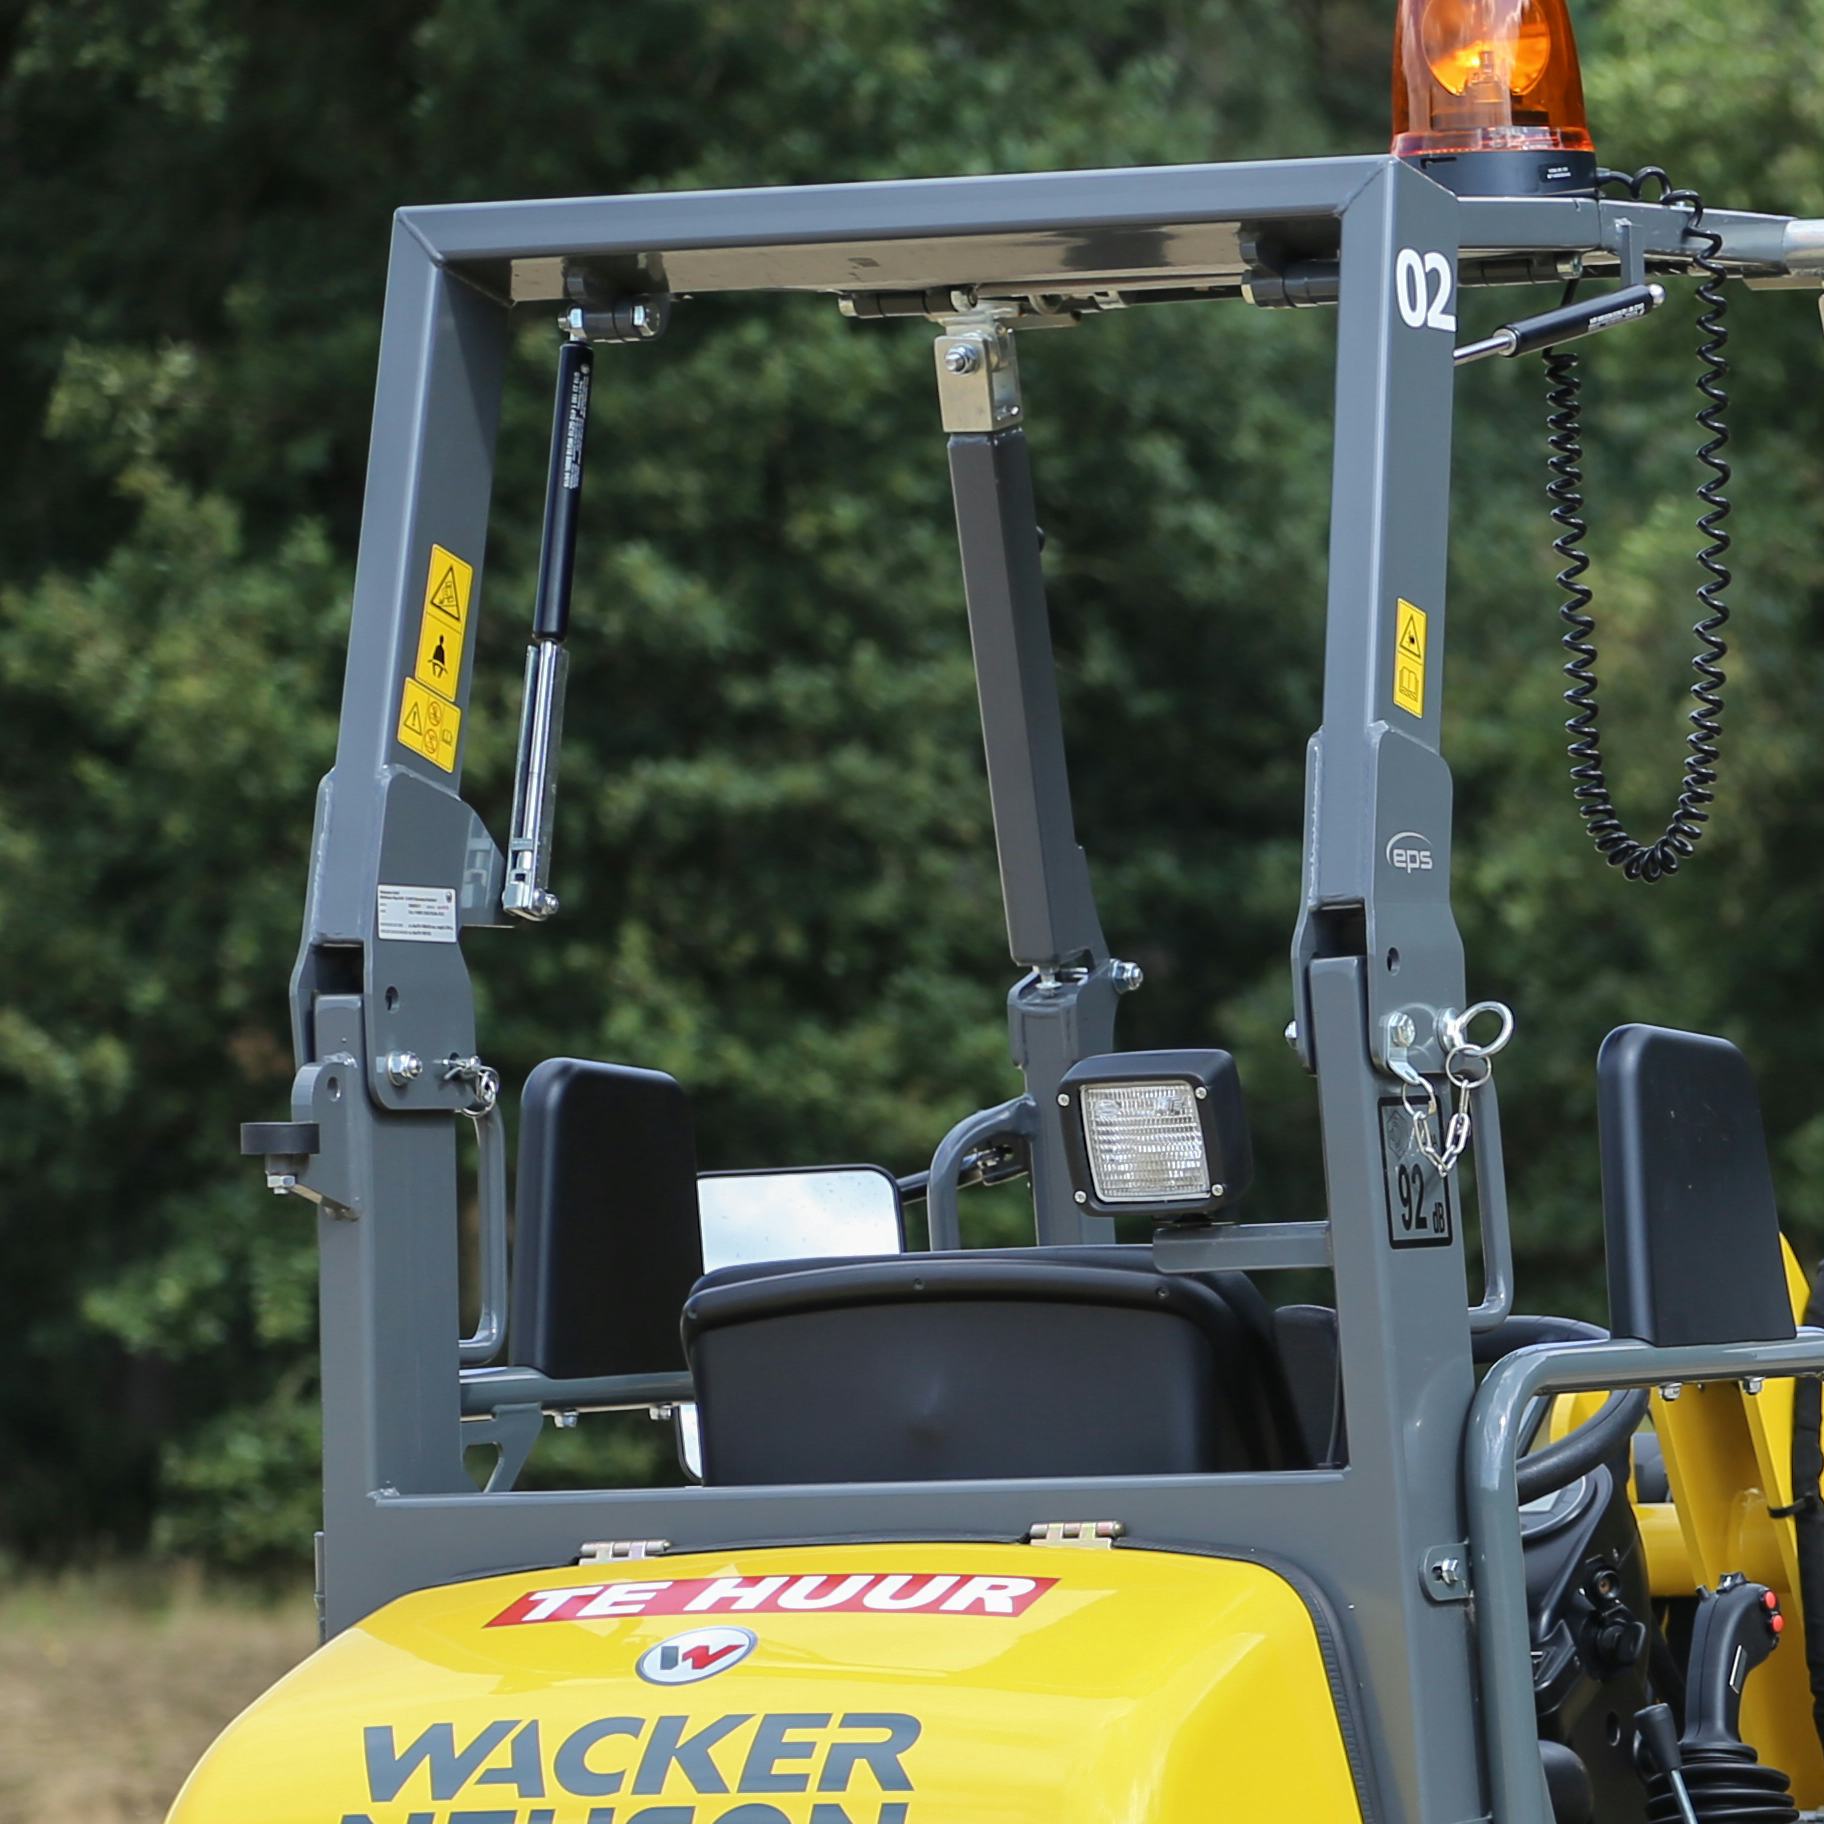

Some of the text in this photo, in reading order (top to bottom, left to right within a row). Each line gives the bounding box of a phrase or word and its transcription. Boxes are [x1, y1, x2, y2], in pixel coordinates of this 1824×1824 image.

[1396, 248, 1457, 332] 02
[1392, 848, 1433, 874] eps
[1398, 1163, 1445, 1234] 92 dB
[521, 1575, 1037, 1622] TE HUUR
[363, 1712, 922, 1803] WACKER
